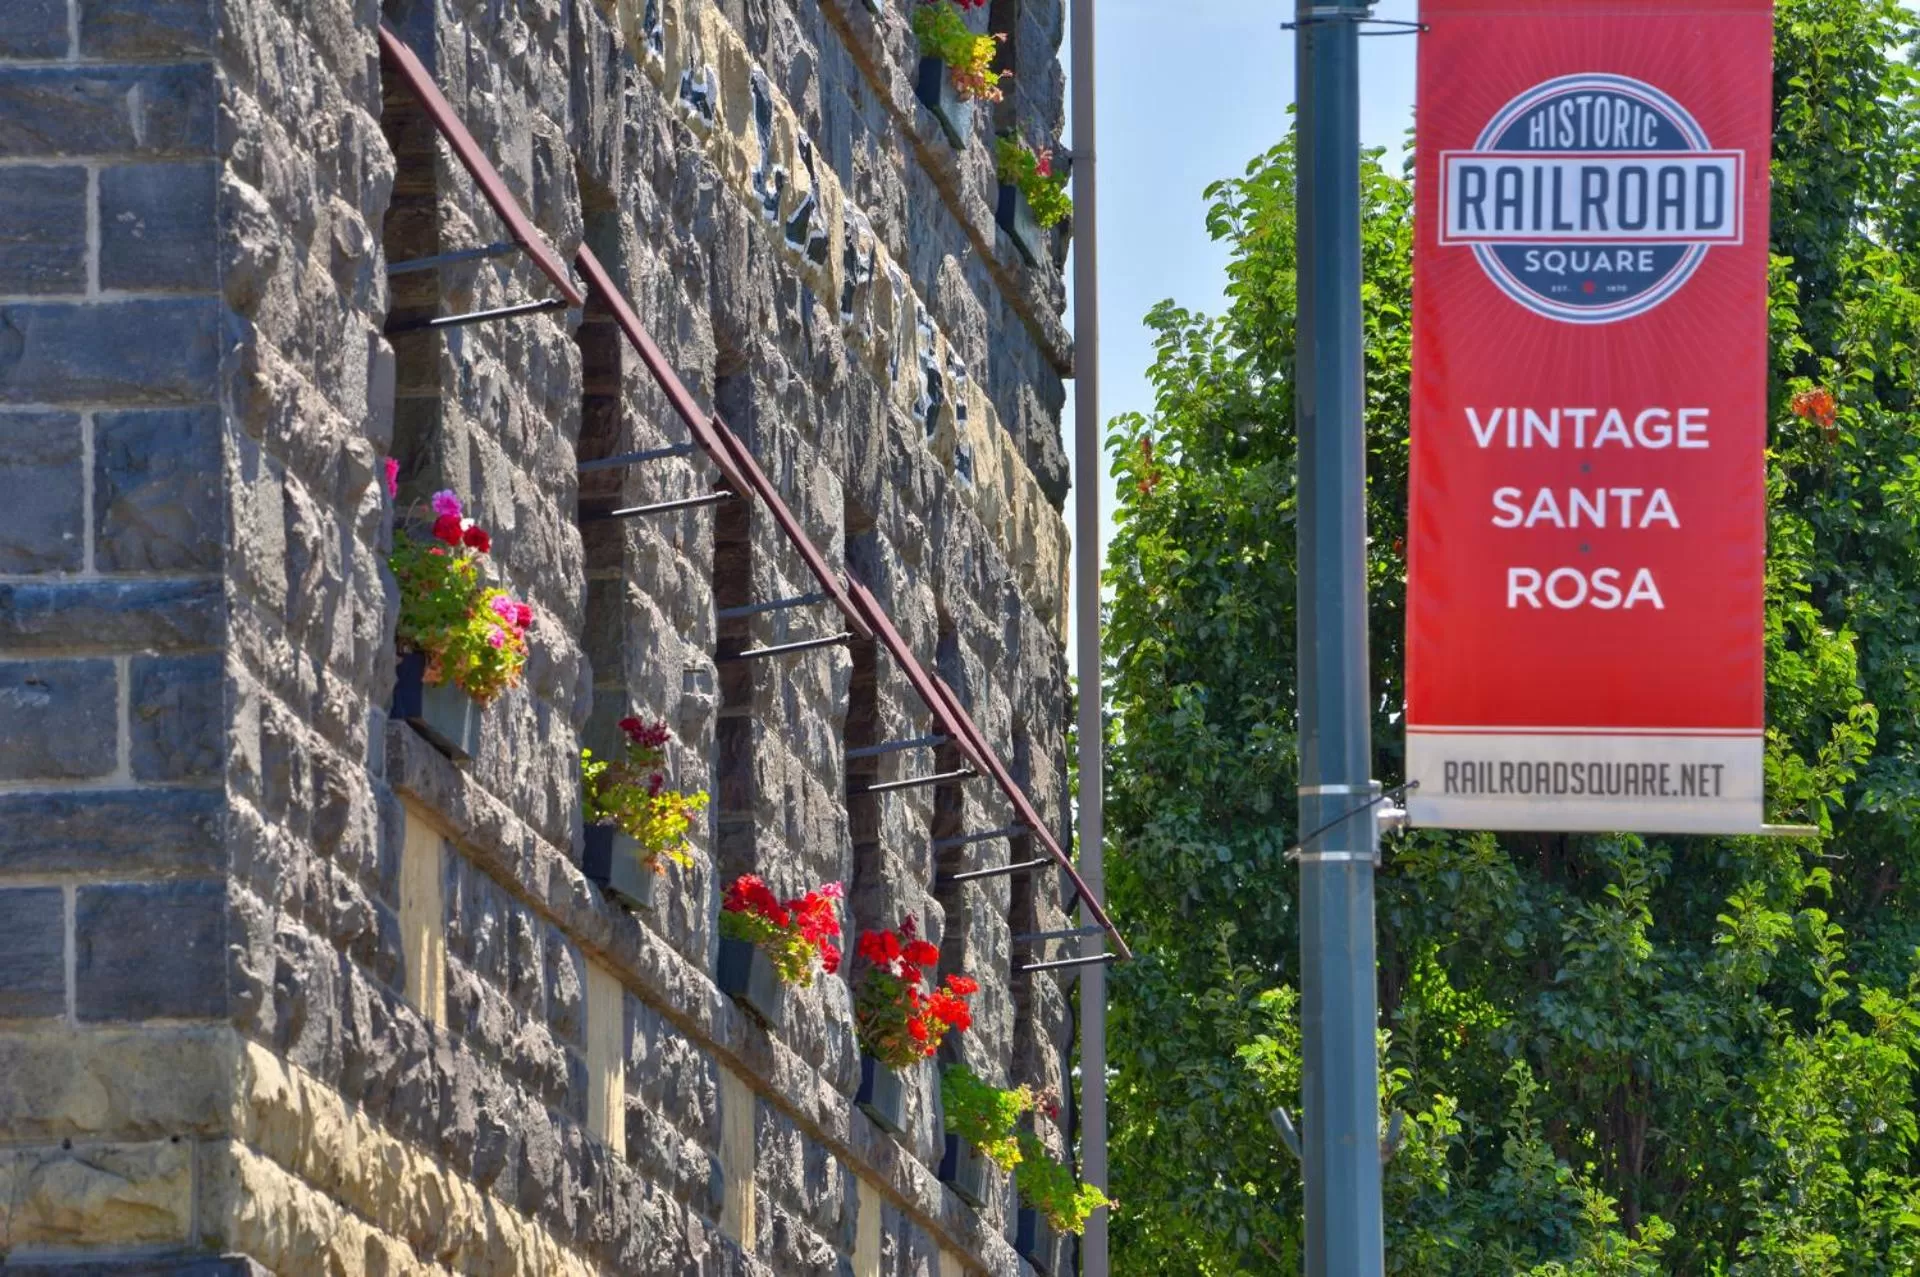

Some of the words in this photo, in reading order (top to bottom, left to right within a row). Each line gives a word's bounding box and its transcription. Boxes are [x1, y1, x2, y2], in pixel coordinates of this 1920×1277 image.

[1529, 95, 1658, 147] HISTORIC
[1457, 165, 1725, 231] RAILROAD
[1525, 250, 1655, 276] SQUARE
[1464, 407, 1710, 449] VINTAGE
[1492, 487, 1680, 529] SANTA
[1507, 567, 1665, 610] ROSA
[1443, 760, 1725, 797] RAILROADSQUARE.NET
